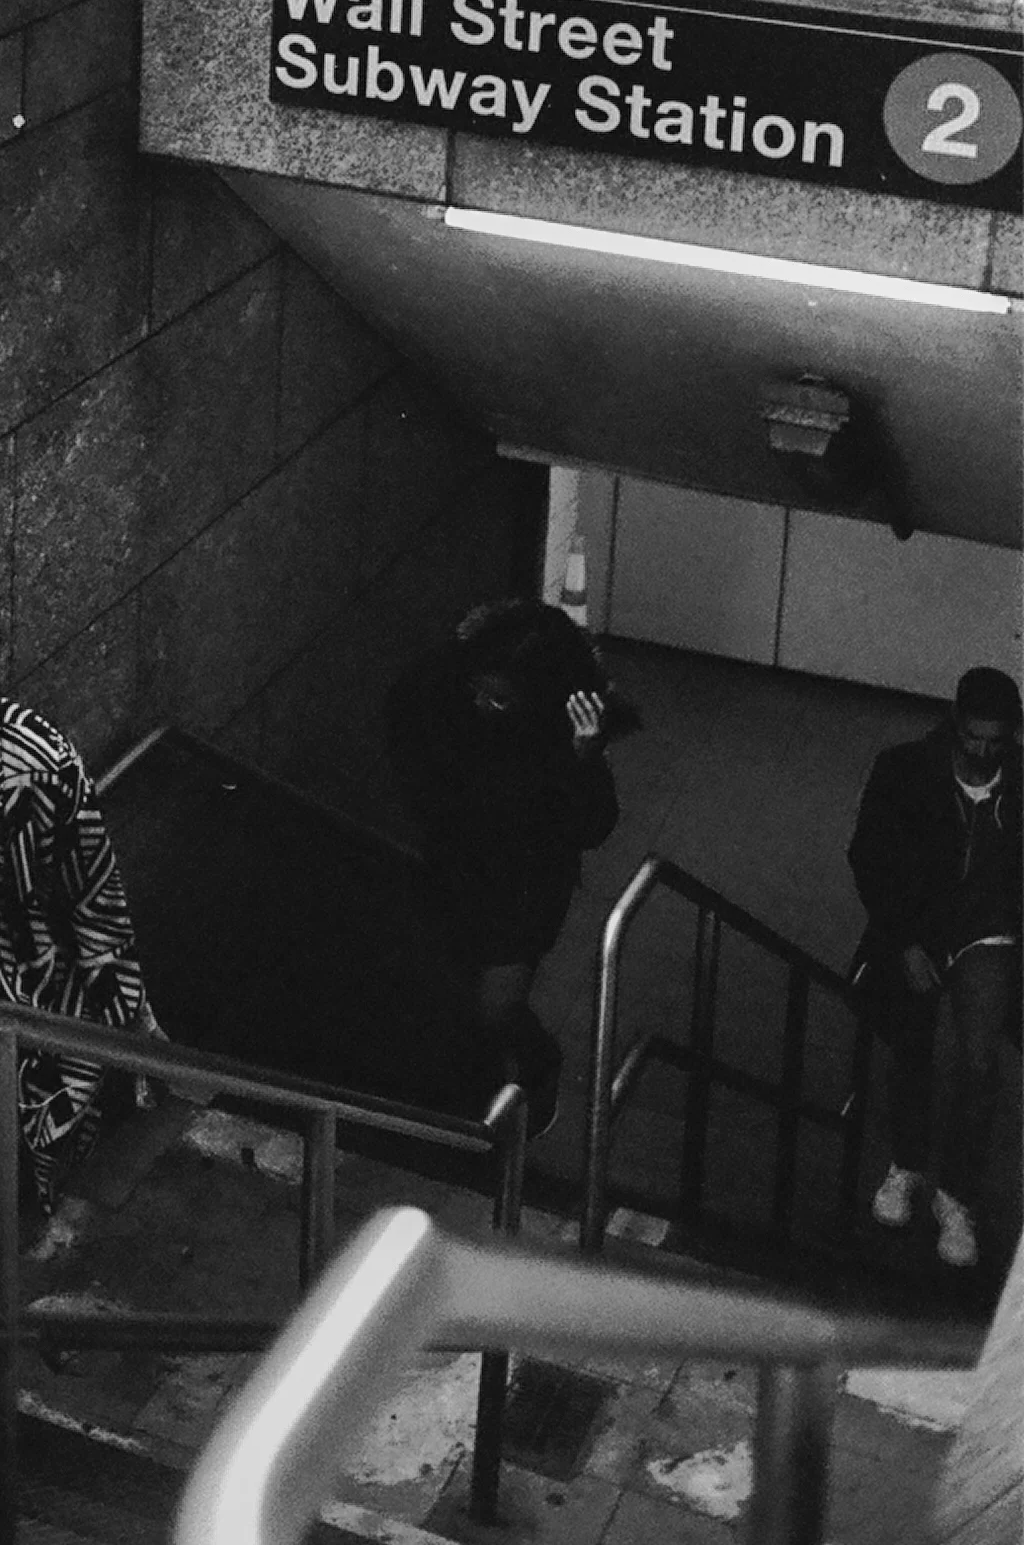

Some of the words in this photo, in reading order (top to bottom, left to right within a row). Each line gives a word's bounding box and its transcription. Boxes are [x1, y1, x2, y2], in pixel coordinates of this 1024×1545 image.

[275, 34, 552, 133] Subway
[575, 74, 847, 167] Station
[921, 82, 981, 159] 2
